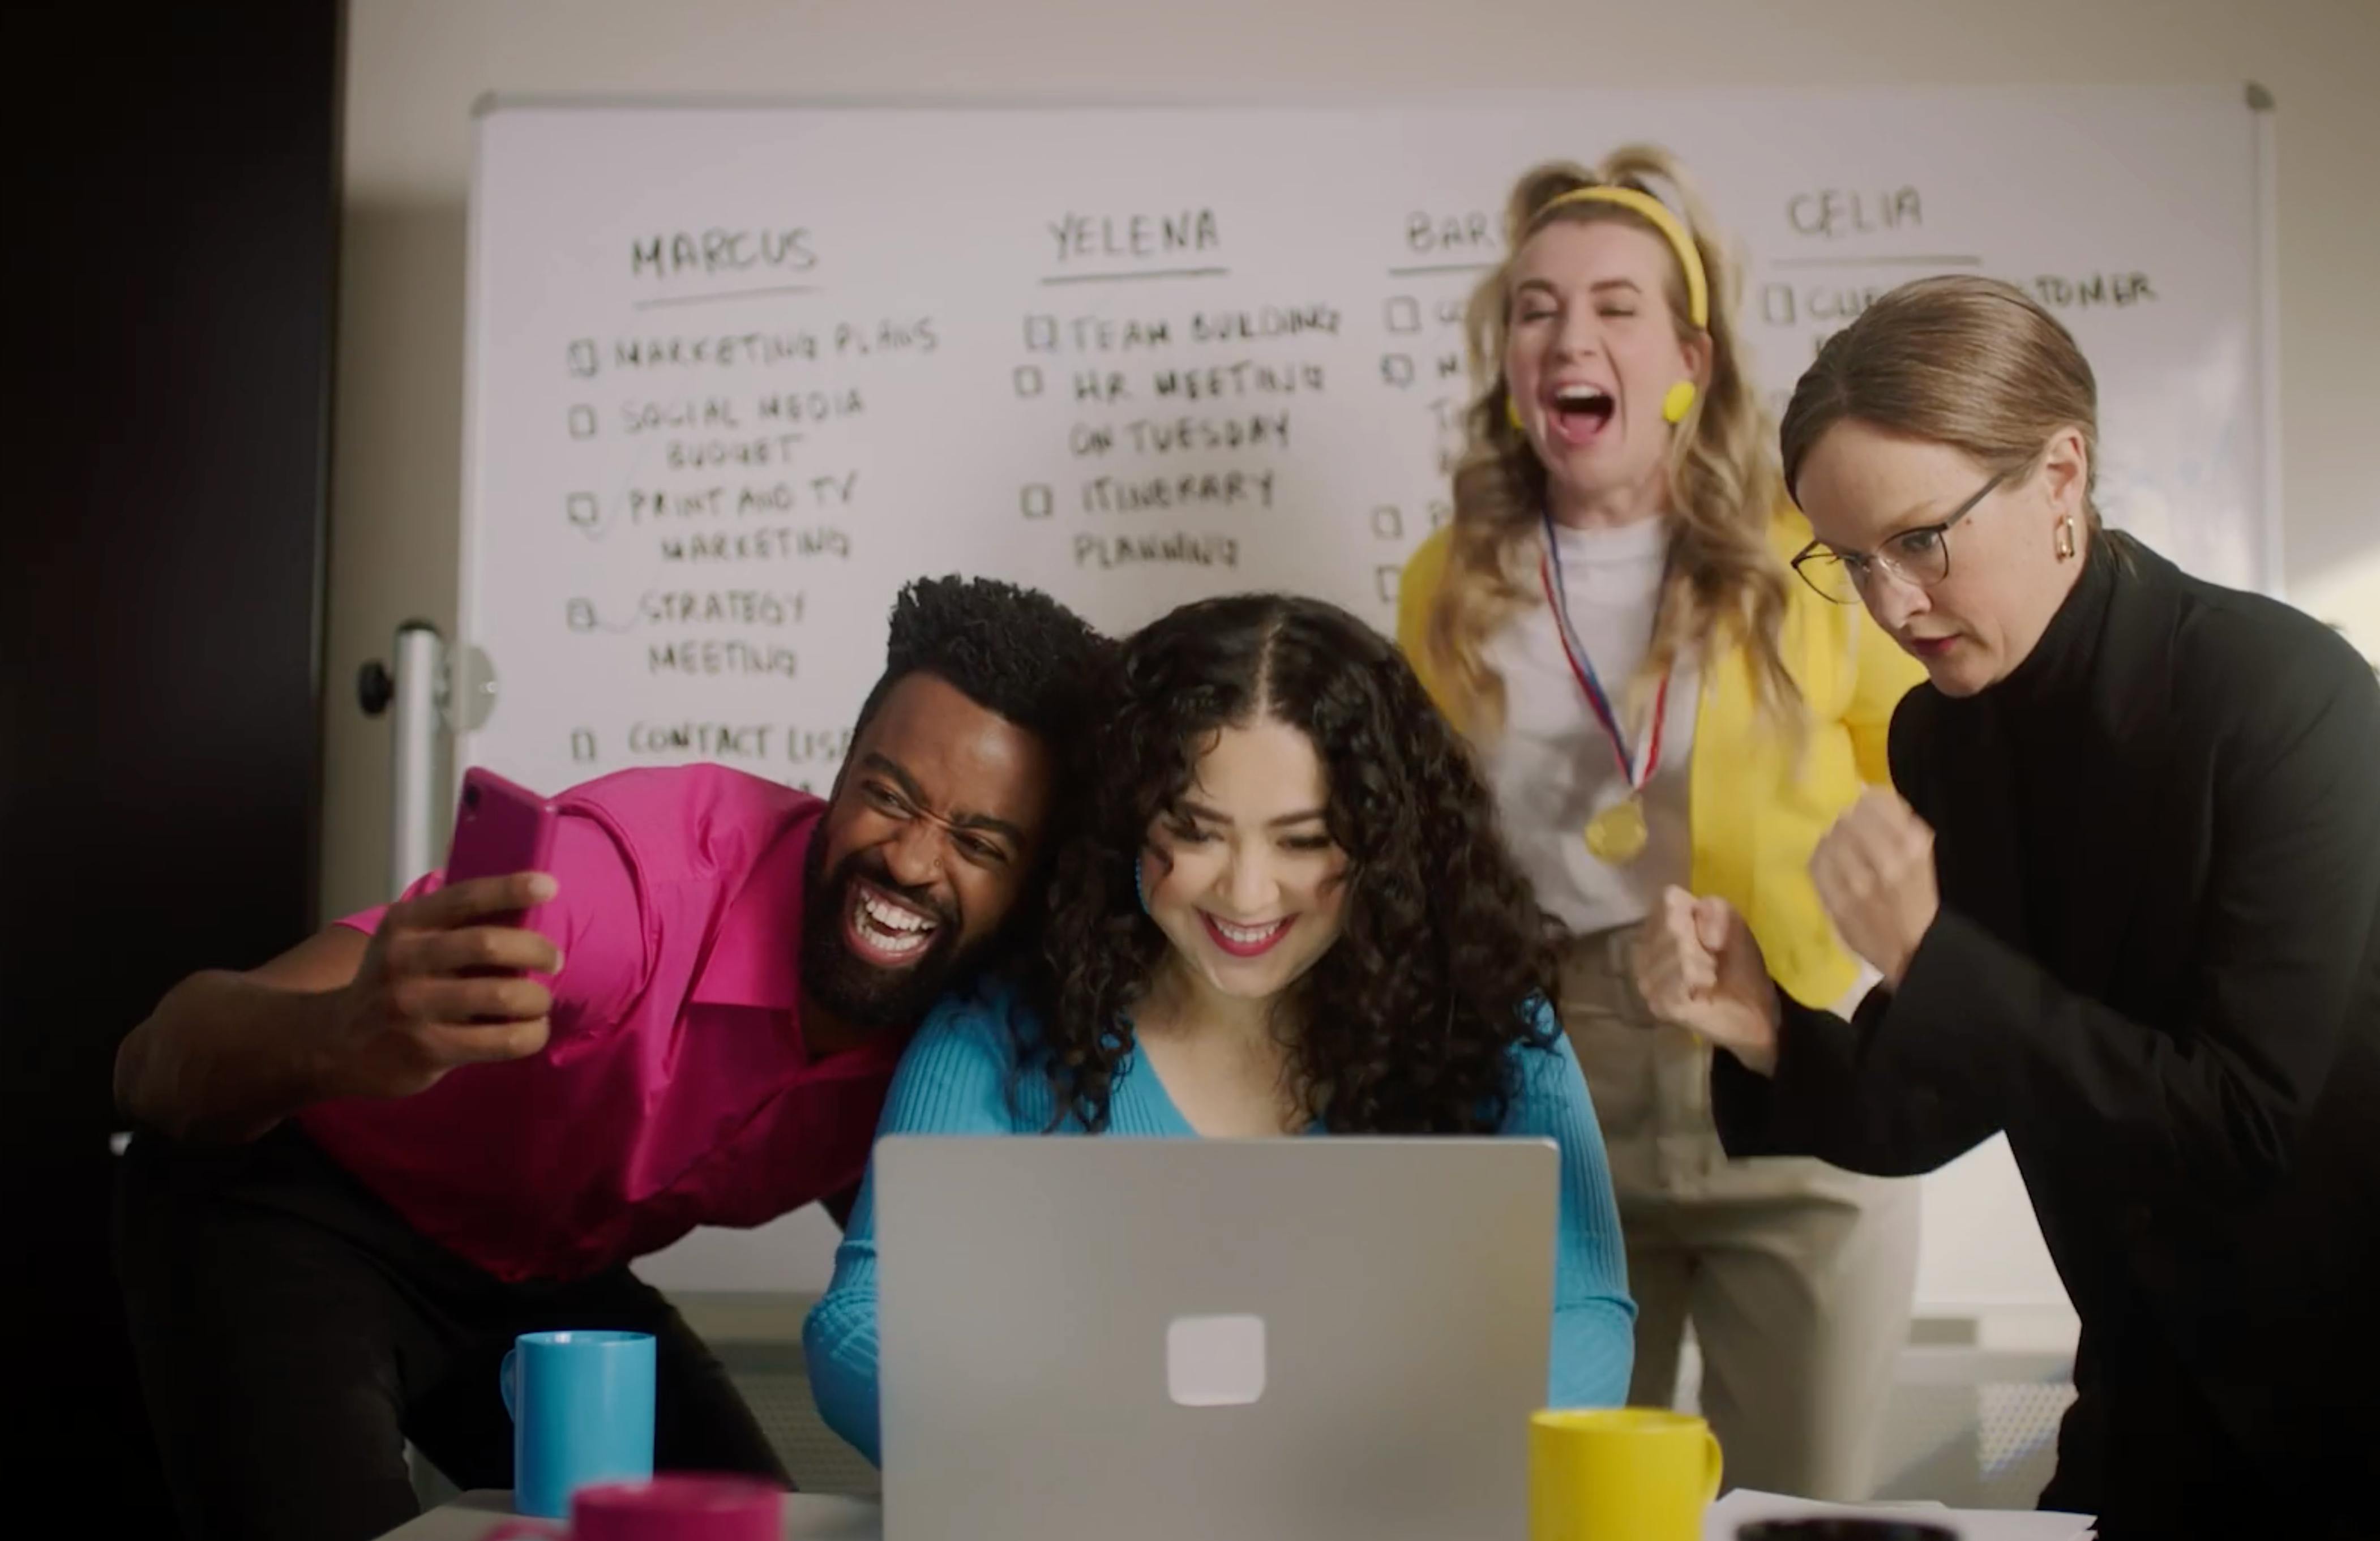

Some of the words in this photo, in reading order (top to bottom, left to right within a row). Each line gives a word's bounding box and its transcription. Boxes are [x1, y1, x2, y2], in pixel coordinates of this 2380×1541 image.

[1786, 187, 1924, 237] CELIA
[631, 228, 817, 276] MARCUS
[1047, 209, 1219, 260] YELENA
[614, 334, 819, 368] MARKETING
[834, 316, 939, 354] PLANS
[1069, 316, 1170, 350] TEAM
[1075, 365, 1128, 403] HR
[1153, 361, 1326, 400] MEETING
[623, 402, 738, 434] SOCIAL
[759, 389, 864, 423] MEDIA
[665, 434, 803, 470] BUDGET
[1071, 423, 1115, 457] ON
[1124, 410, 1290, 453] TUESDAY
[627, 488, 724, 524] PRINT
[738, 482, 793, 514] AND
[807, 470, 856, 505] TV
[1081, 470, 1275, 512] ITINERARY
[660, 528, 850, 560] MARKETING
[1073, 532, 1240, 568] PLANNING
[637, 589, 807, 624] STRATEGY
[648, 643, 797, 677] MEETING
[627, 720, 776, 760] CONTACT
